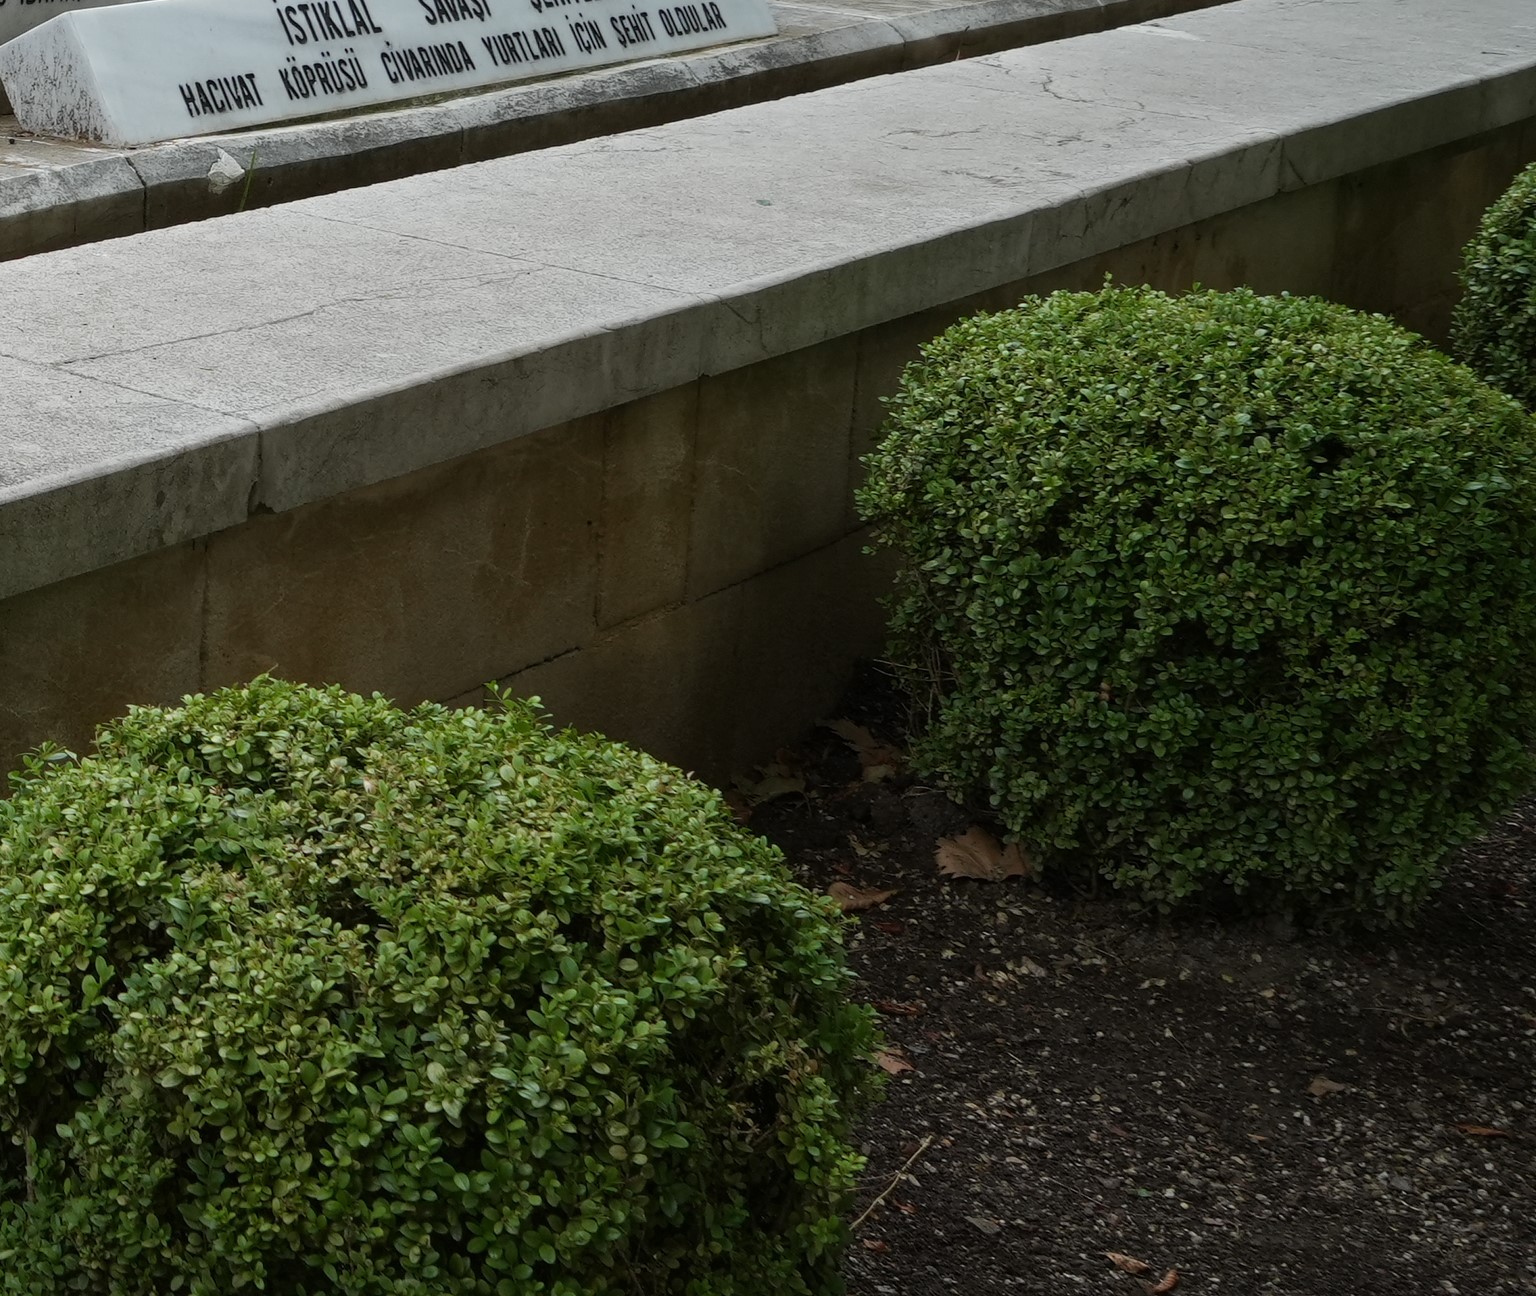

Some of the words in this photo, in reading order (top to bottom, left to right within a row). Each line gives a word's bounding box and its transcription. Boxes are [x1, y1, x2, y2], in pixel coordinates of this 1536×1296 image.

[179, 73, 263, 117] HACIVAT
[278, 48, 368, 101] KÖPRÜSÜ
[380, 40, 476, 84] CİVARINDA
[481, 26, 566, 67] YURTLARI
[564, 12, 608, 54] İÇİN
[610, 4, 656, 48] ŞEHİT
[658, 1, 727, 39] OLDULAR
